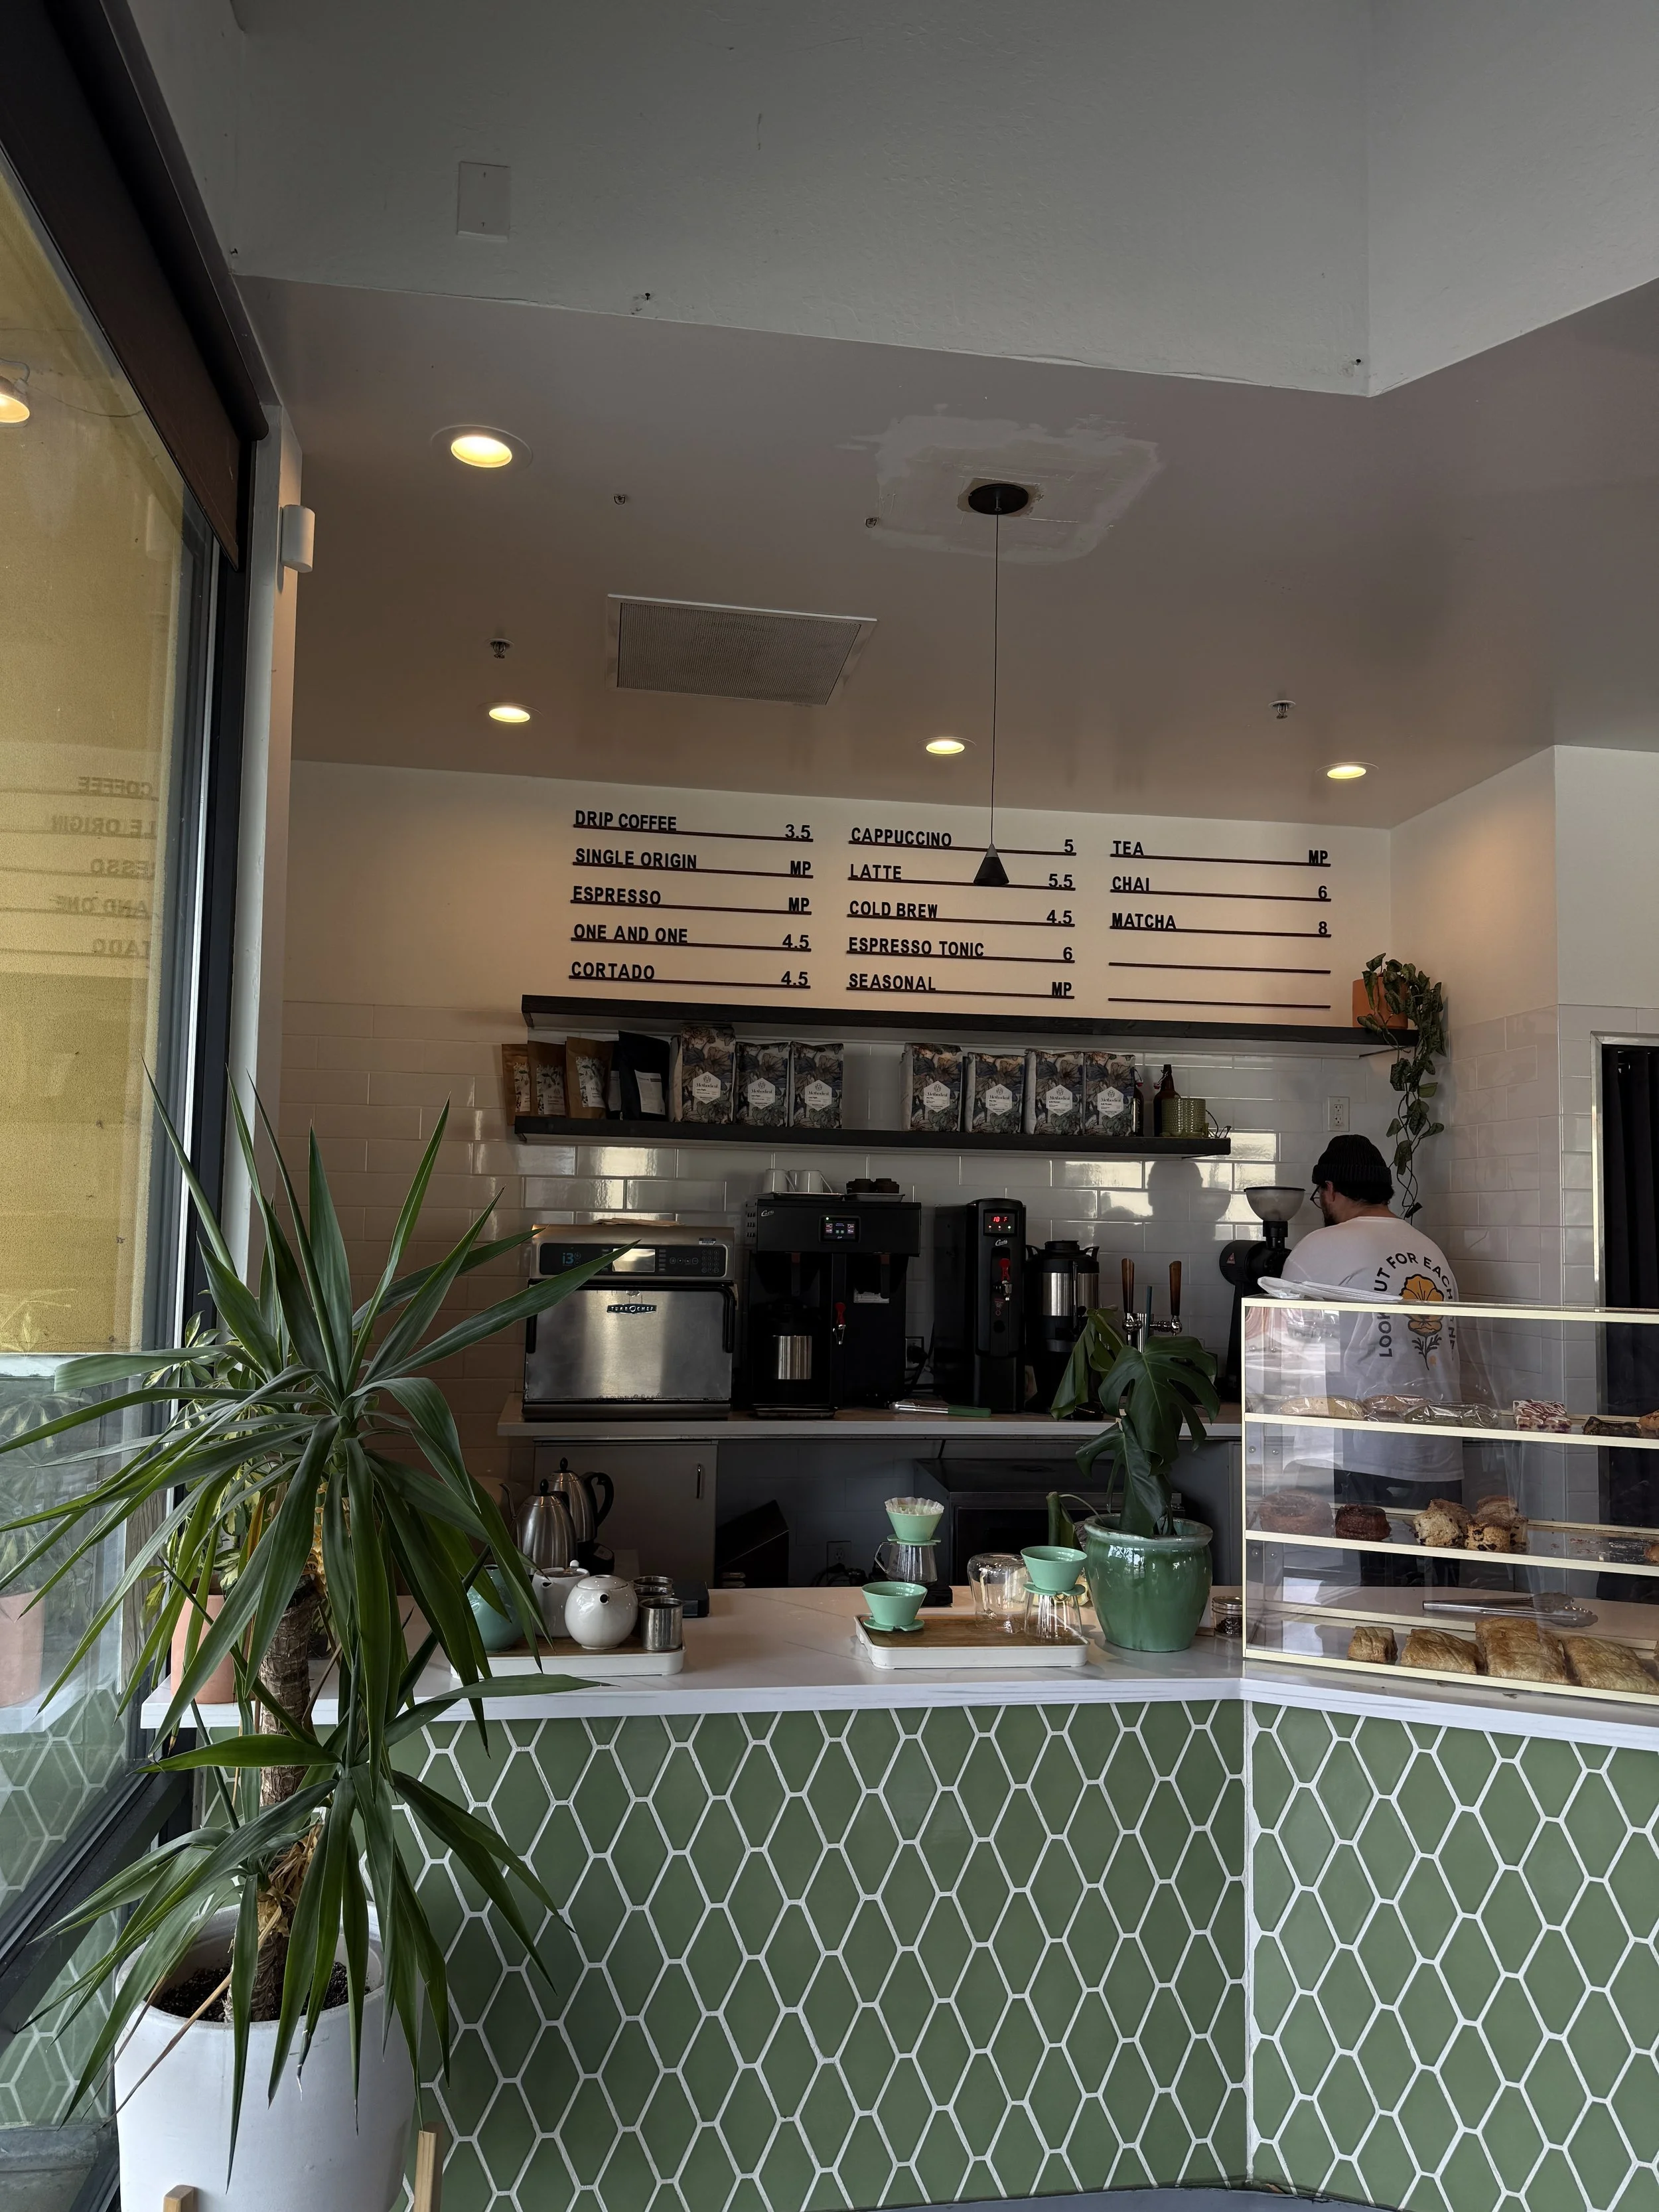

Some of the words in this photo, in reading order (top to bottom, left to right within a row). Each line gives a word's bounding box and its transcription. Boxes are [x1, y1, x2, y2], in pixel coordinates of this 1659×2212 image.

[575, 810, 613, 827] DRIP
[618, 813, 677, 831] COFFEE
[785, 824, 811, 840] 3.5
[851, 828, 952, 847] CAPPUCCINO
[1064, 839, 1074, 853] 5
[1113, 840, 1144, 855] TEA
[1309, 849, 1329, 864] MP
[575, 848, 634, 865] SINGLE
[640, 852, 697, 869] ORIGIN
[790, 861, 812, 875] MP
[850, 864, 901, 881] LATTE
[1048, 873, 1073, 889] 5.5
[1112, 876, 1149, 891] CHAI
[1318, 885, 1327, 899] 6
[573, 886, 661, 905] ESPRESSO
[788, 897, 810, 912] MP
[849, 901, 891, 917] COLD
[897, 903, 938, 919] BREW
[1046, 910, 1072, 924] 4.5
[1112, 913, 1177, 929] MATCHA
[1319, 921, 1327, 934] 8
[574, 924, 607, 940] ONE
[614, 926, 649, 942] AND
[655, 928, 688, 944] ONE
[782, 934, 810, 949] 4.5
[849, 937, 932, 955] ESPRESSO
[939, 940, 984, 957] TONIC
[1063, 946, 1073, 960] 6
[571, 962, 655, 980] CORTADO
[781, 971, 808, 986] 4.5
[849, 973, 936, 991] SEASONAL
[1052, 982, 1072, 996] MP
[562, 1252, 574, 1264] i3
[1374, 1267, 1391, 1292] UT
[1386, 1252, 1419, 1269] FOR
[1423, 1256, 1453, 1299] EACH
